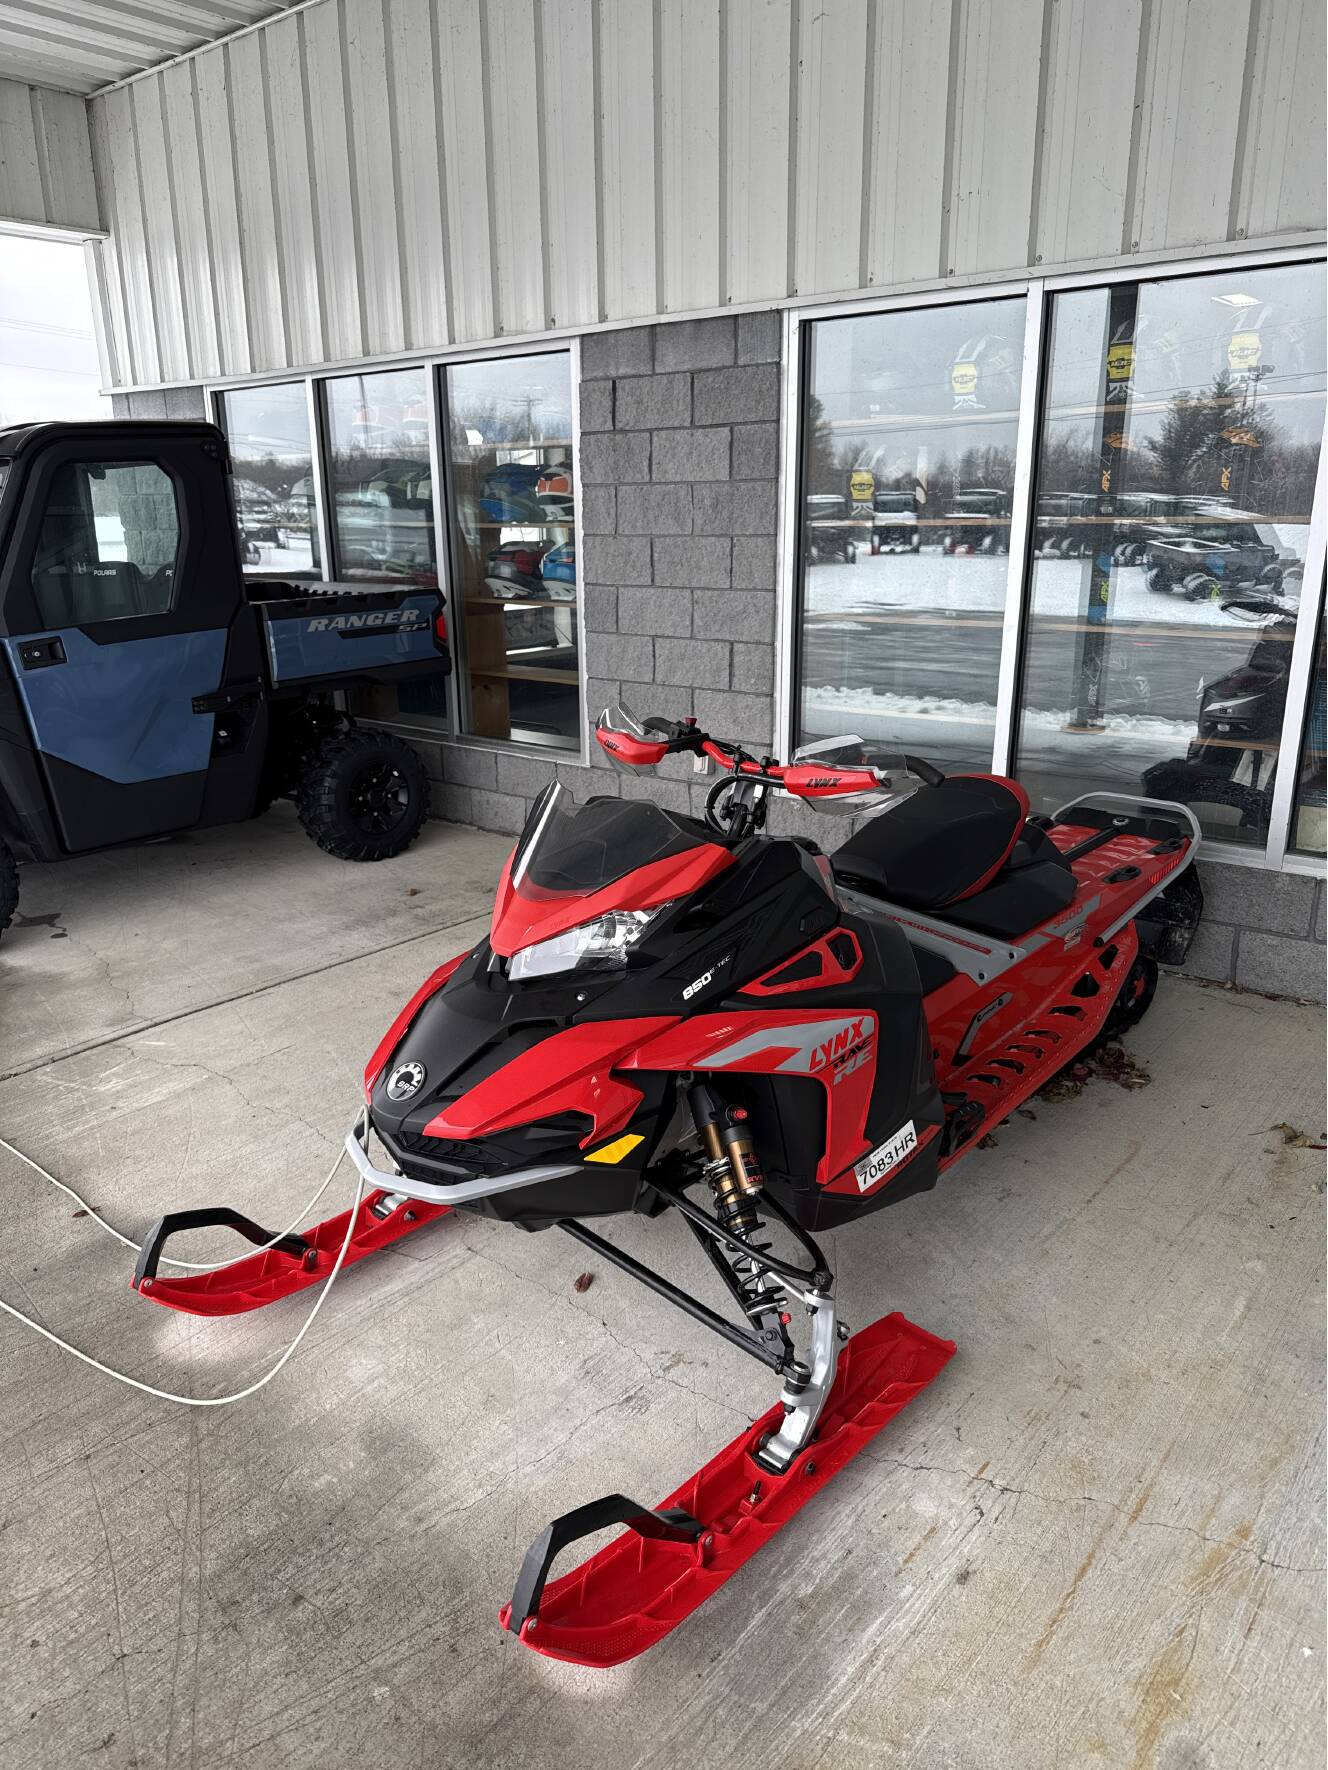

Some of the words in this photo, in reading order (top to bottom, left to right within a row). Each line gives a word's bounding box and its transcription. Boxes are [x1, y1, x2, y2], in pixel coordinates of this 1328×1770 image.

[1101, 469, 1111, 492] AFX
[307, 609, 420, 633] RANGER
[398, 622, 428, 632] SP
[806, 777, 842, 788] LYNX
[682, 971, 712, 1000] 850
[808, 1016, 865, 1072] LYNX
[833, 1043, 874, 1086] RE
[397, 1080, 416, 1092] BRP
[860, 1151, 894, 1186] 7083
[894, 1131, 915, 1157] HR
